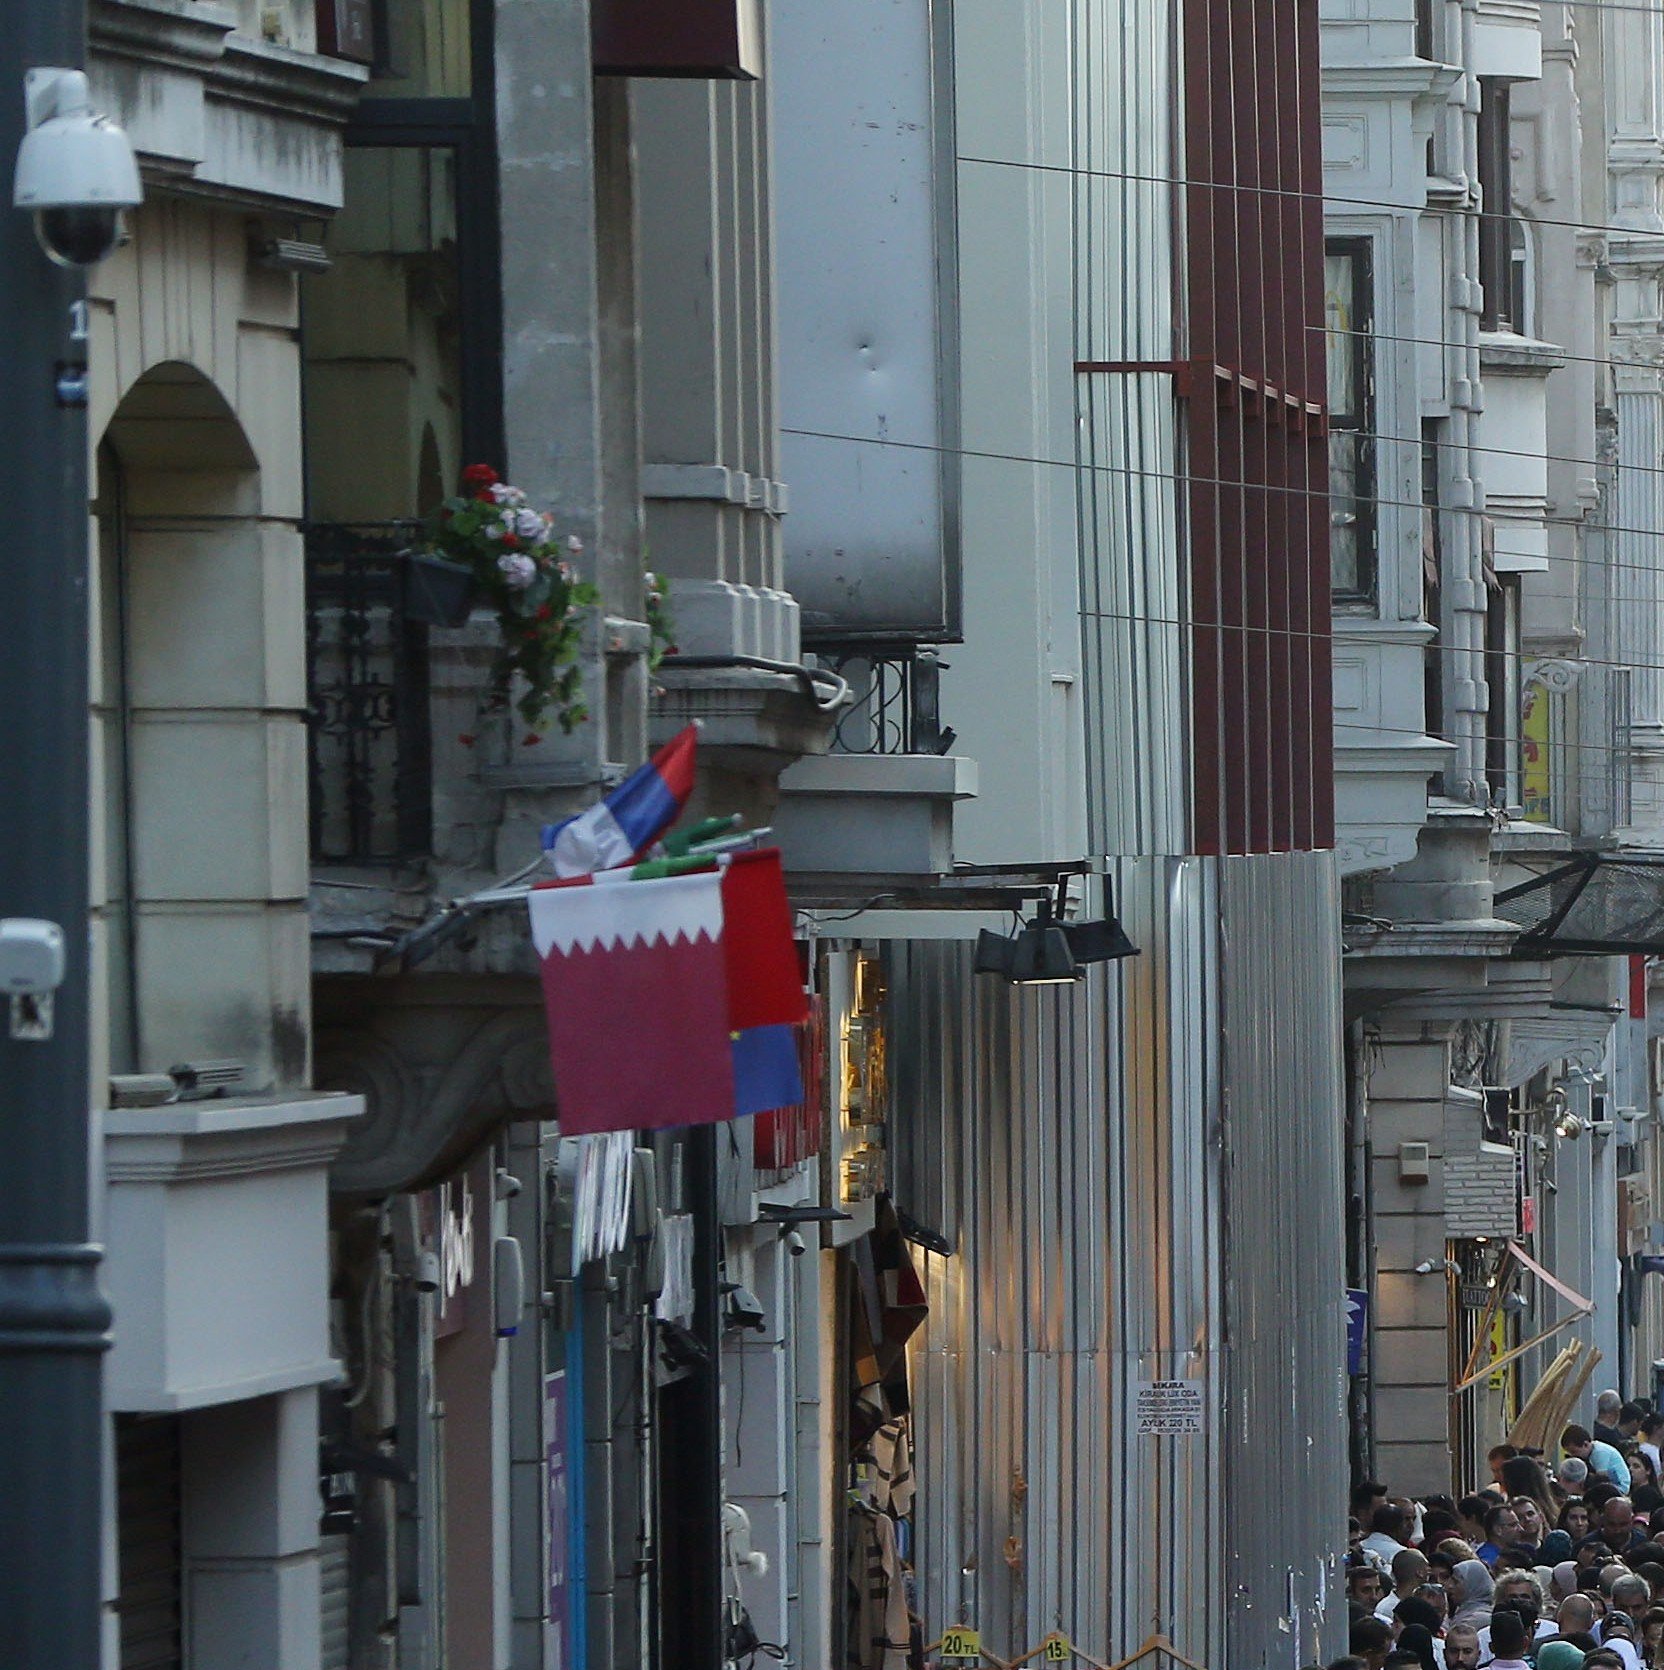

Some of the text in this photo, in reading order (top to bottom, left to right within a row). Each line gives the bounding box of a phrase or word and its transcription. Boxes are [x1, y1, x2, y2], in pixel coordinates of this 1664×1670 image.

[1185, 1419, 1198, 1427] TL
[943, 1635, 978, 1655] 20 TL
[1047, 1642, 1062, 1658] 15
